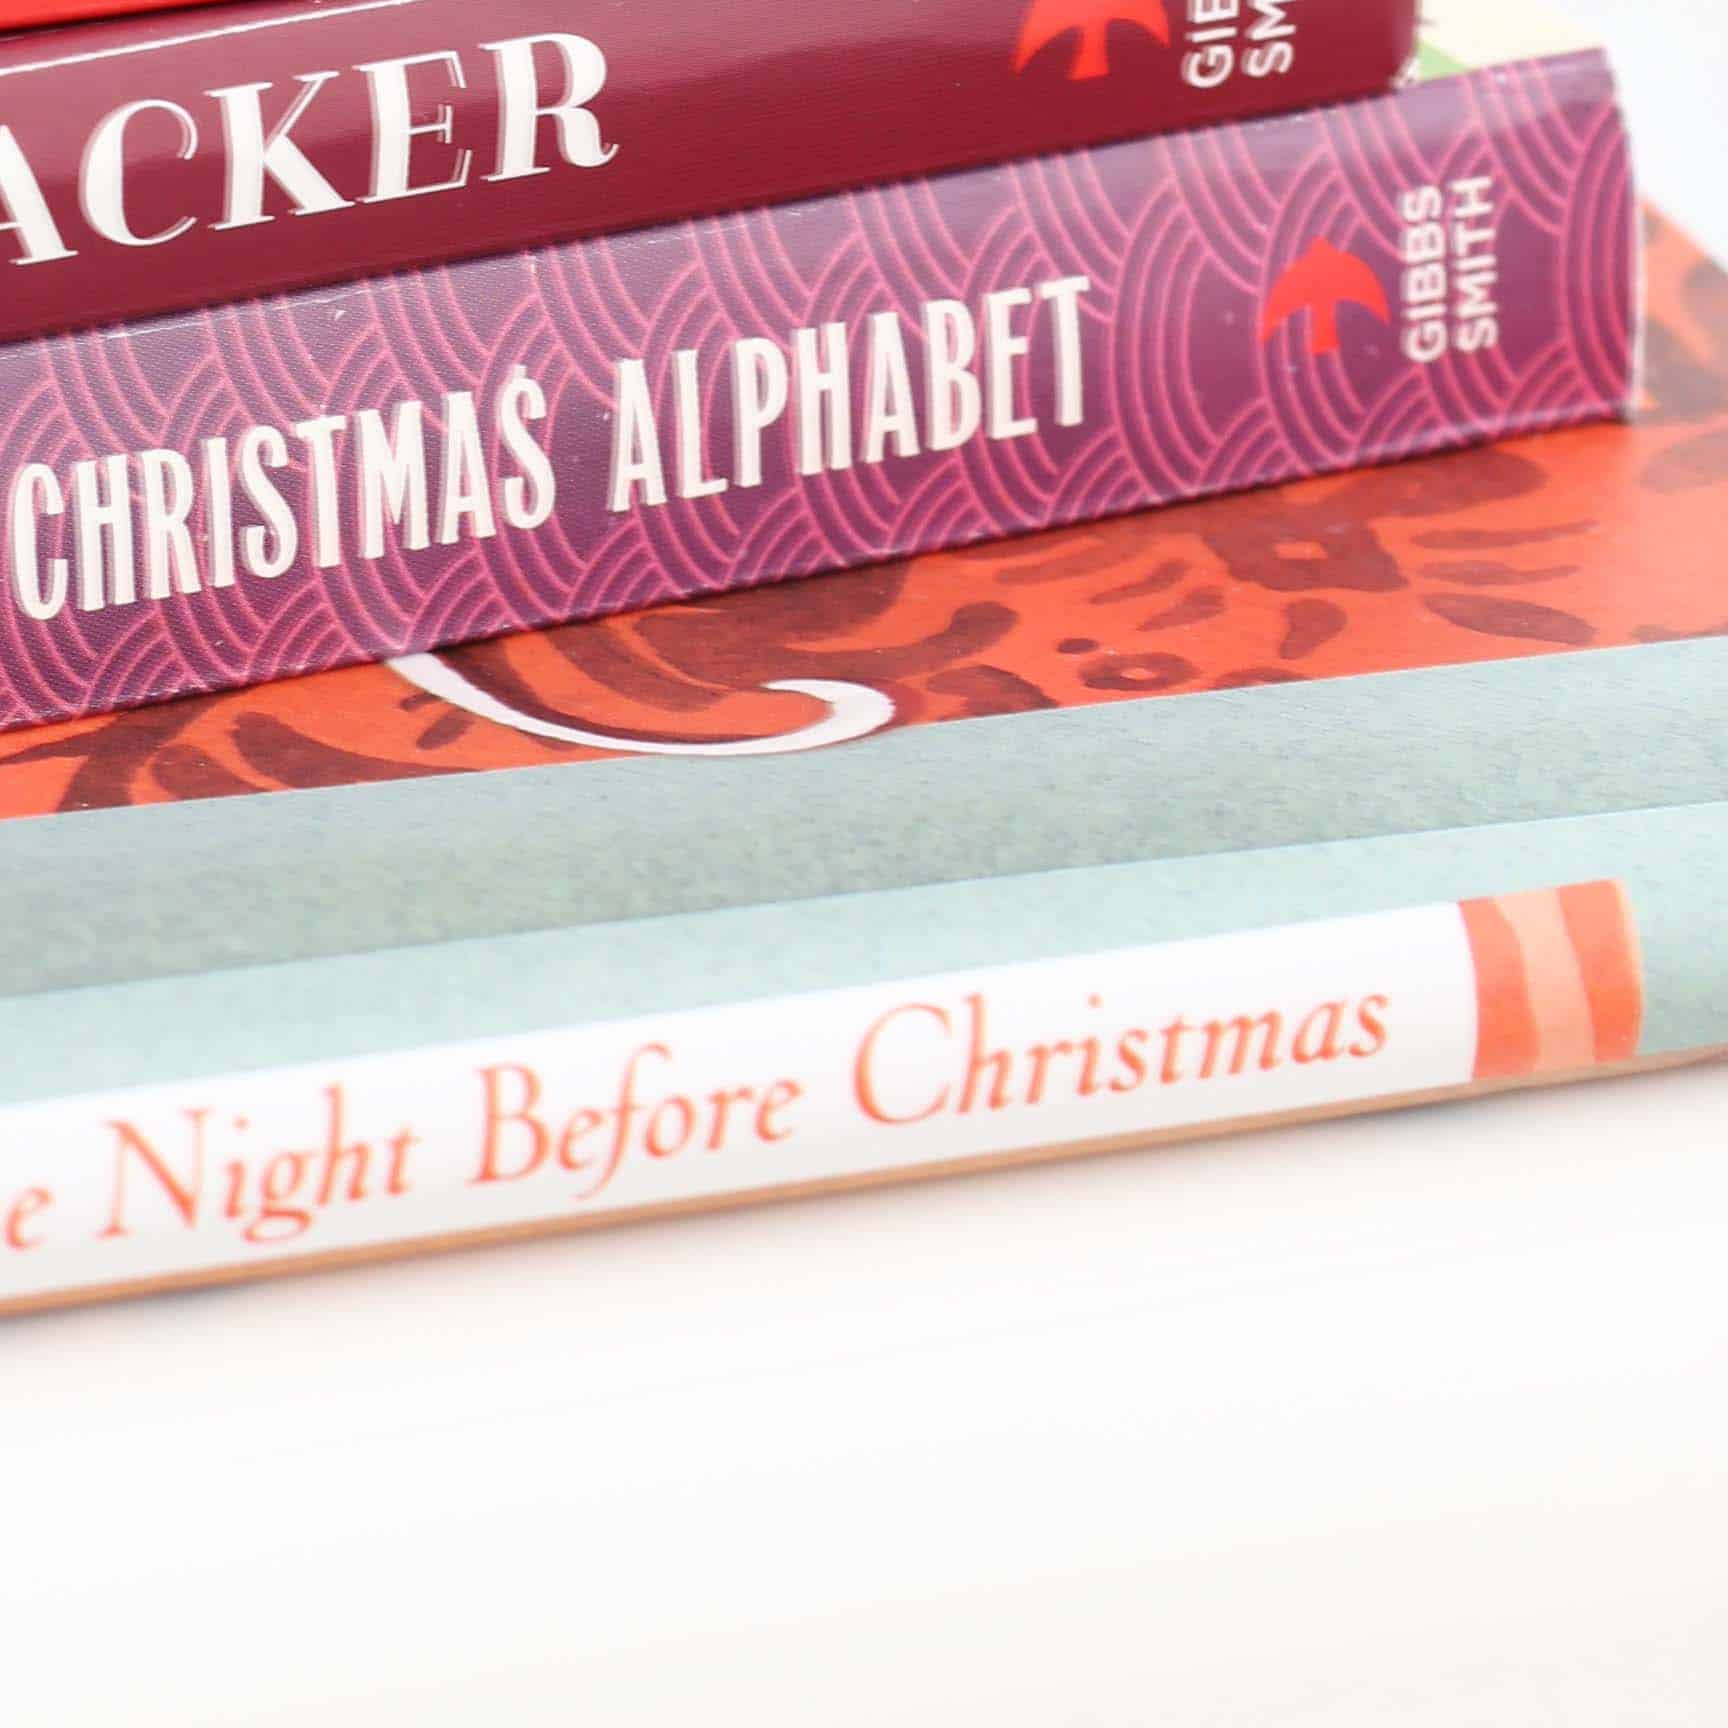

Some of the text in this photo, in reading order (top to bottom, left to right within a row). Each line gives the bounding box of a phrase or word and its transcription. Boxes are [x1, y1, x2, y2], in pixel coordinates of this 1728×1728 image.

[1400, 183, 1449, 364] GIBBS
[1451, 173, 1501, 354] SMITH
[6, 364, 559, 622] CHRISTMAS
[606, 275, 1091, 513] ALPHABET
[99, 1080, 421, 1246] Night
[465, 1040, 806, 1203] Before
[849, 987, 1392, 1127] Christmas
